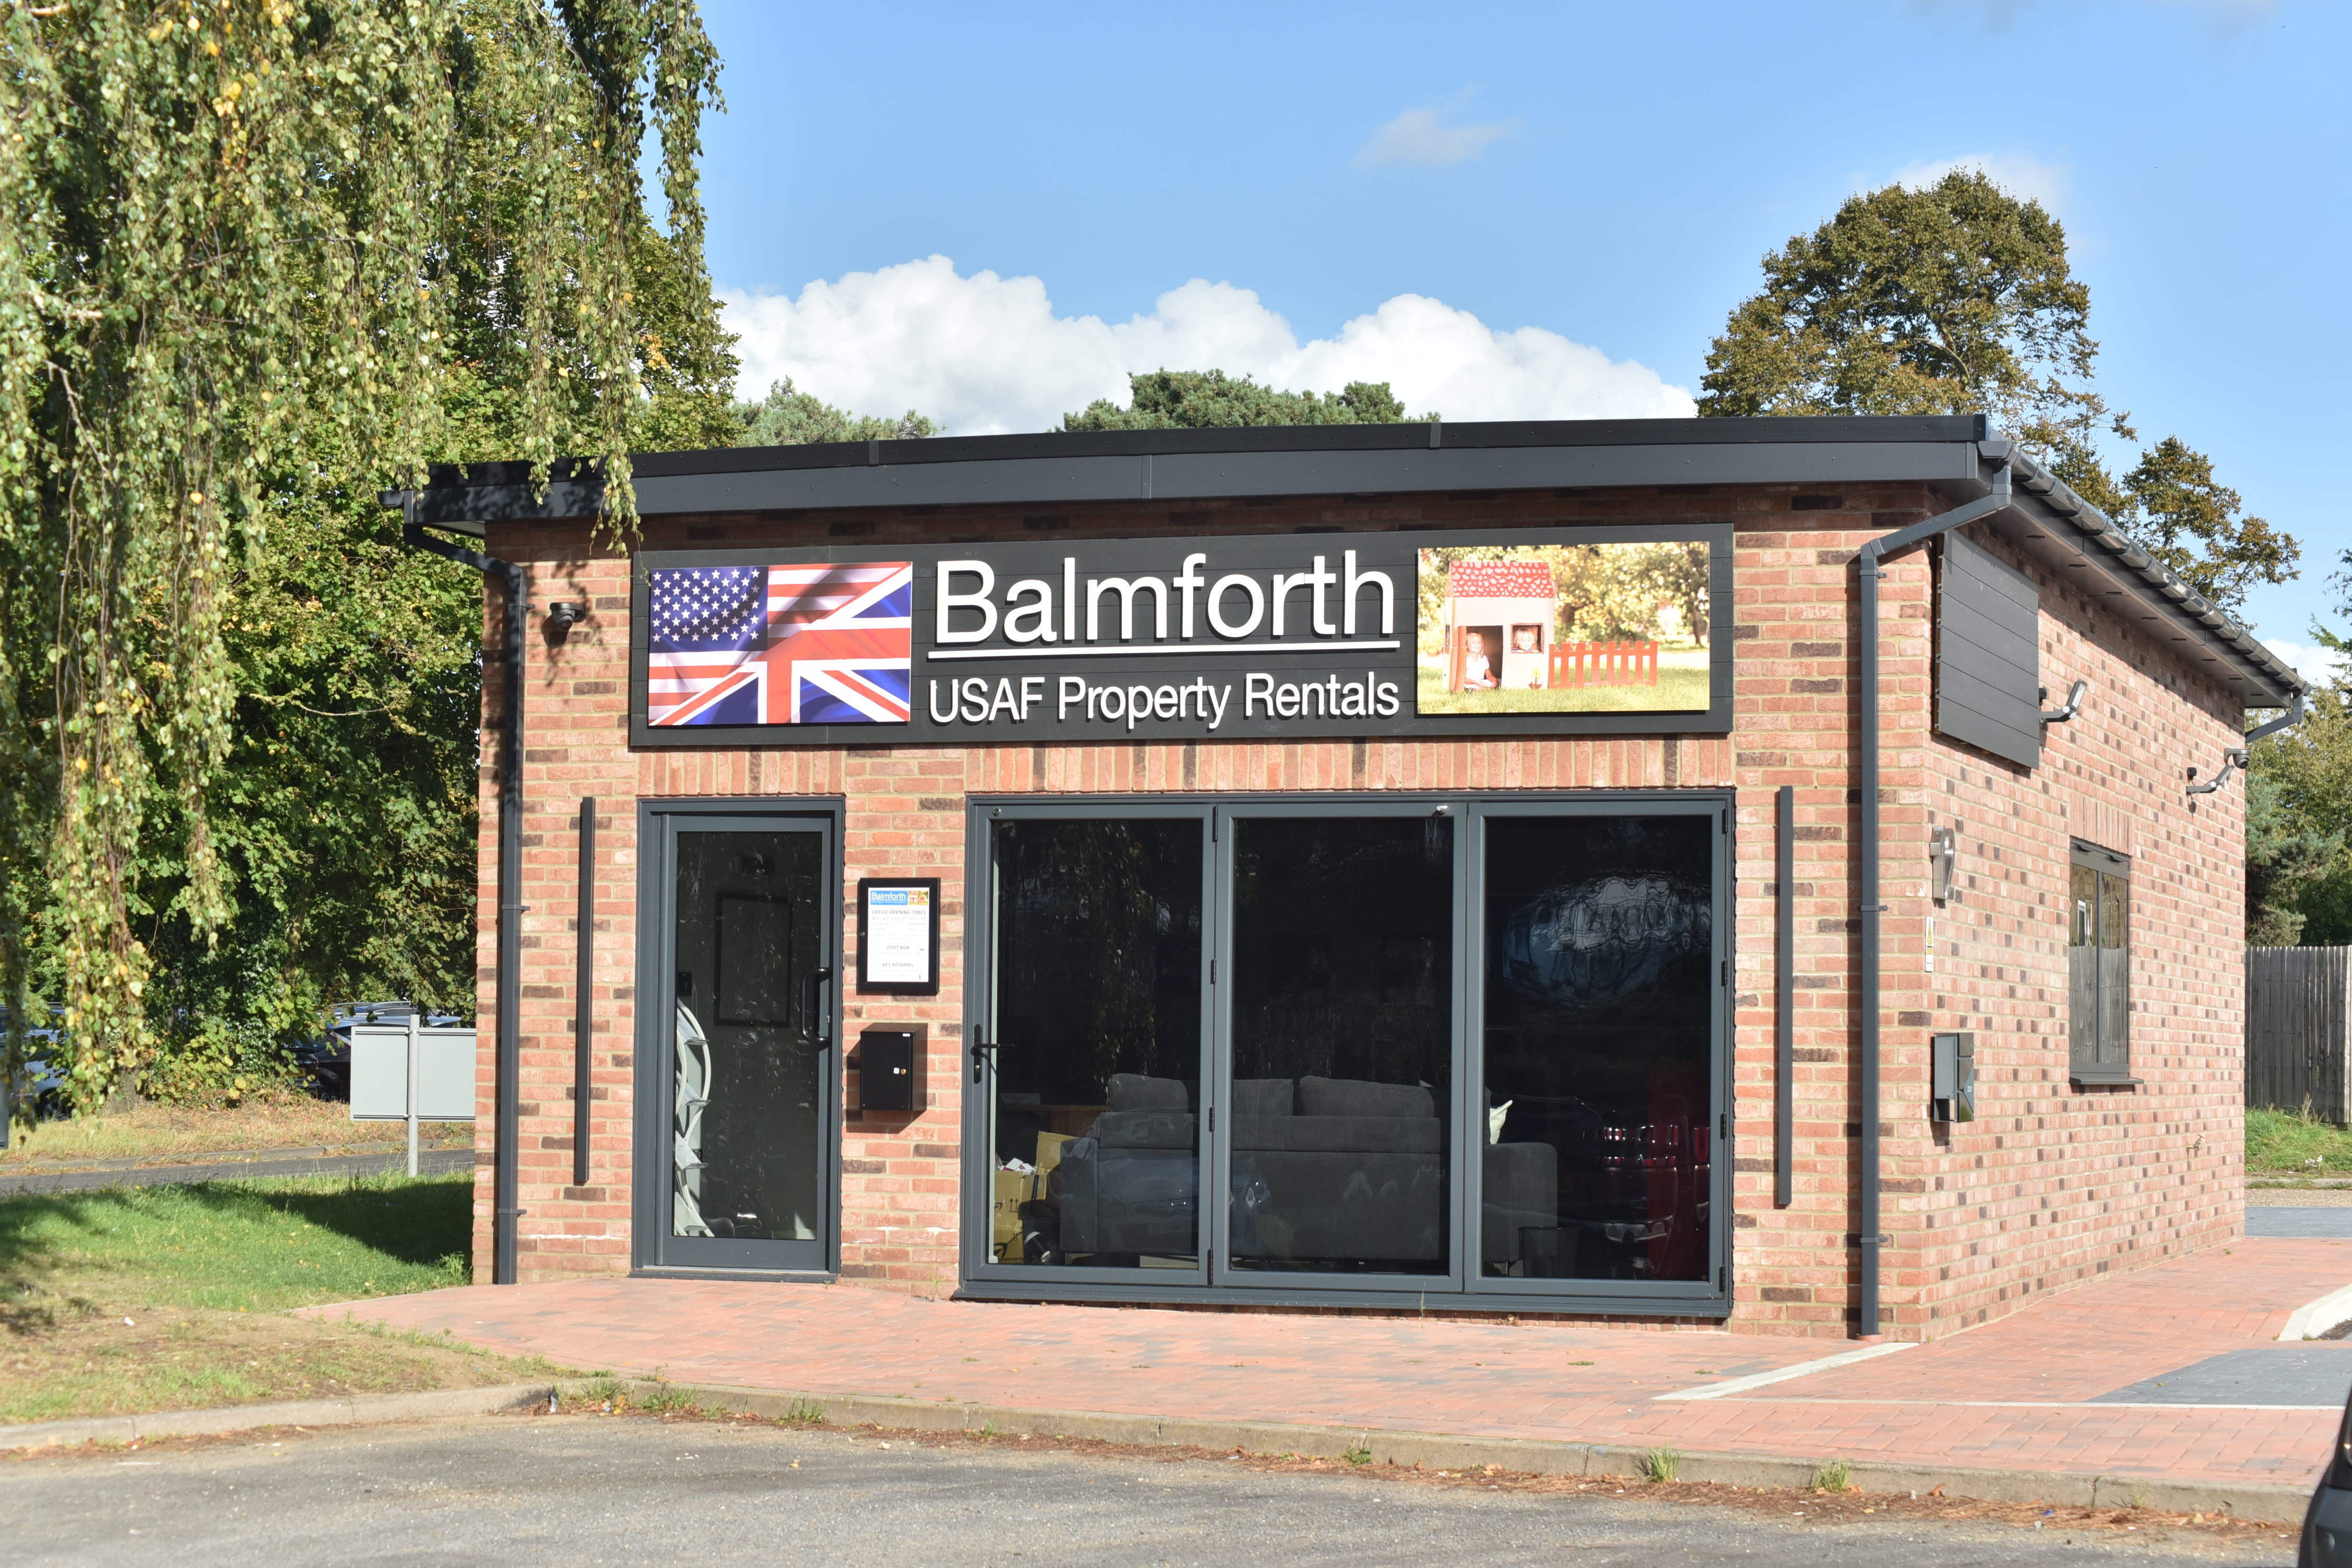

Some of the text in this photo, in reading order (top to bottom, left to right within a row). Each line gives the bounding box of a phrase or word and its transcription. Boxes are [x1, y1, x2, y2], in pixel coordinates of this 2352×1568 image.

[937, 550, 1394, 643] Balmforth
[929, 671, 1400, 730] USAF Property Rentals
